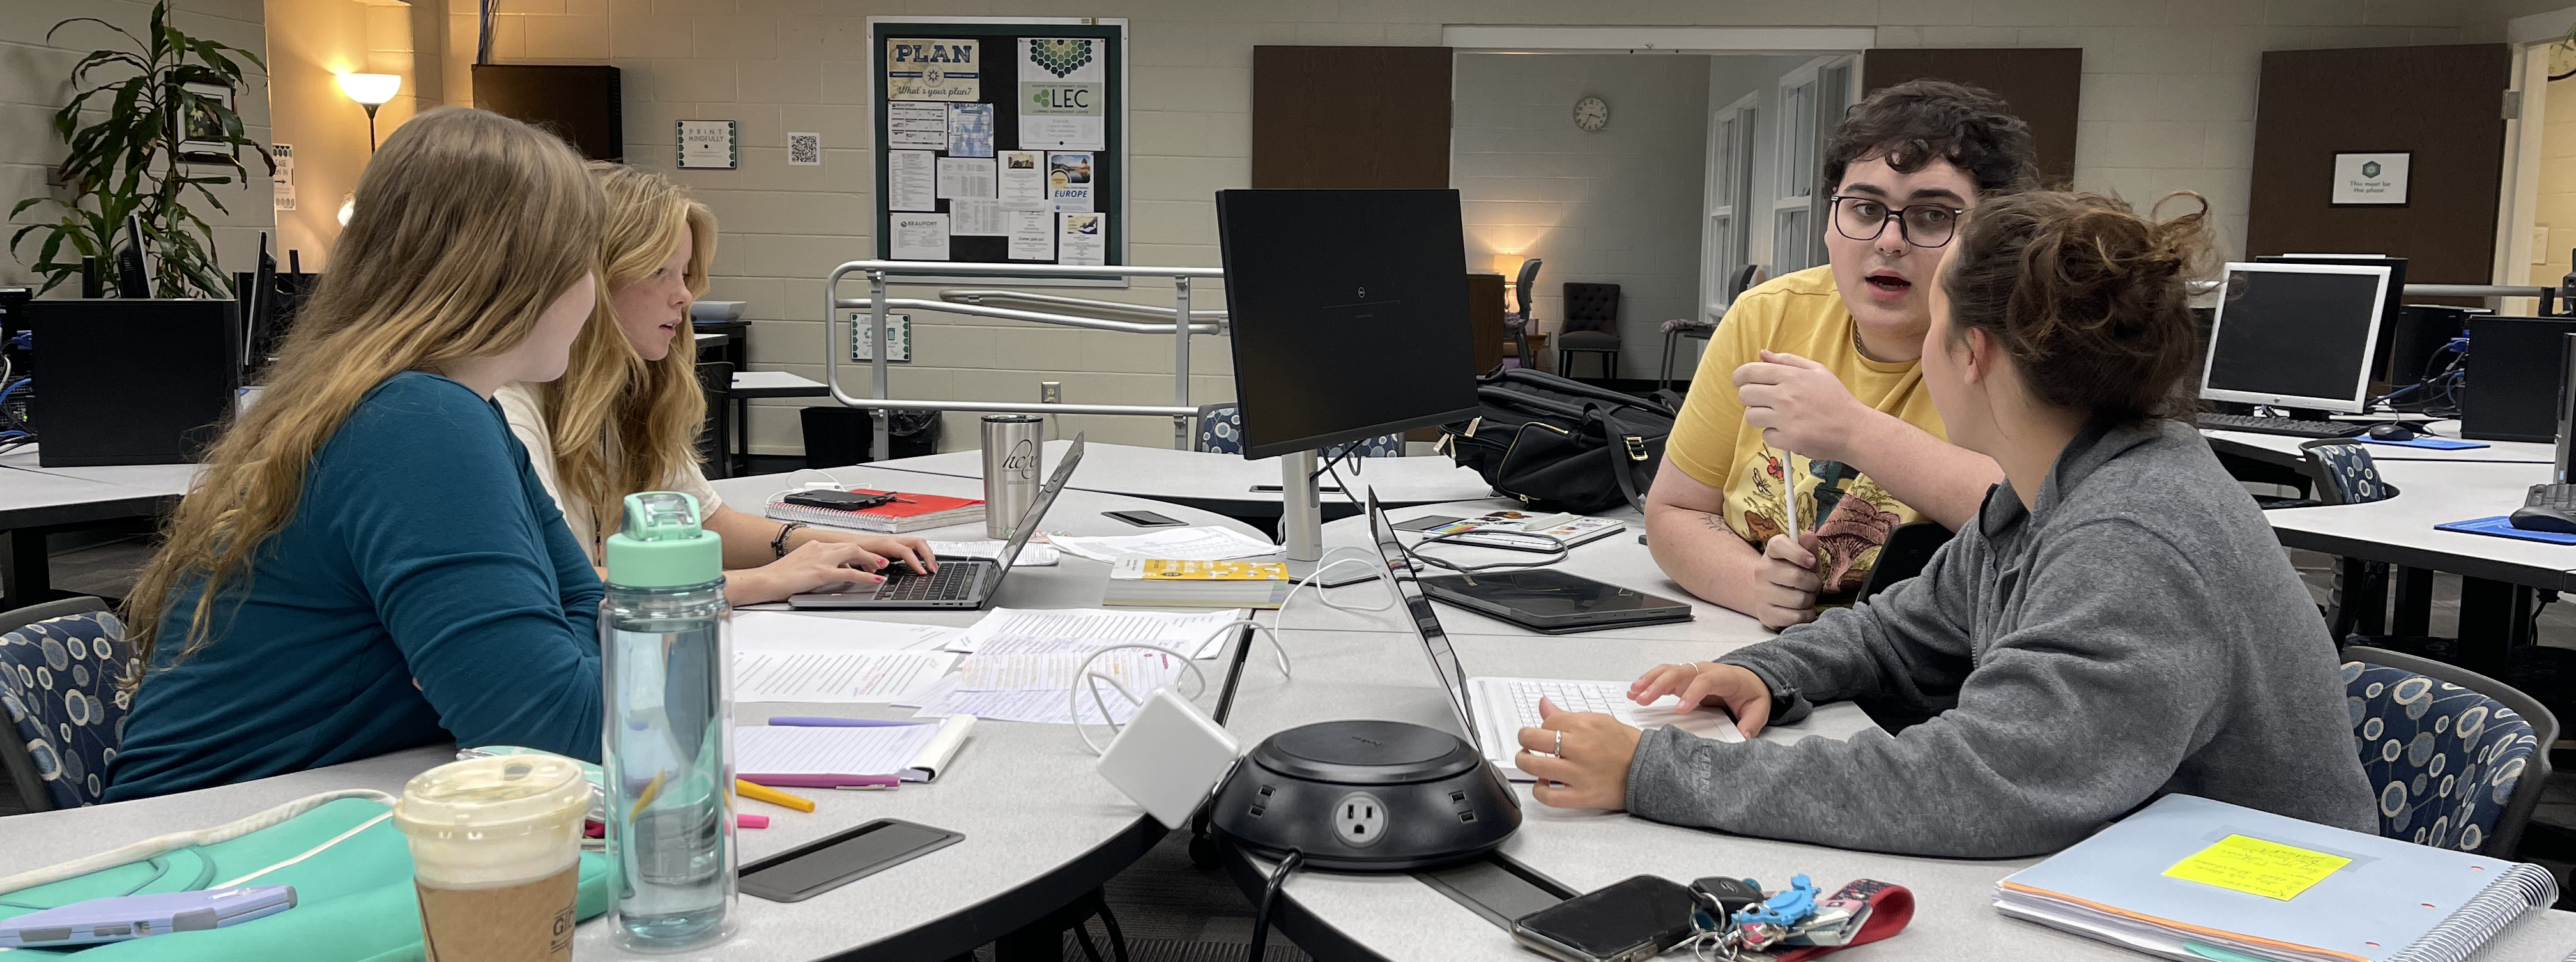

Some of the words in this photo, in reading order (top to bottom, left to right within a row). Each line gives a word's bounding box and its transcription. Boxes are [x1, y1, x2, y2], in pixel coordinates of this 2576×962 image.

[896, 45, 972, 63] PLAN
[897, 86, 927, 95] What's
[928, 89, 947, 98] your
[948, 88, 972, 98] plan?
[1052, 89, 1089, 108] LEC
[1055, 190, 1088, 198] EUROPE
